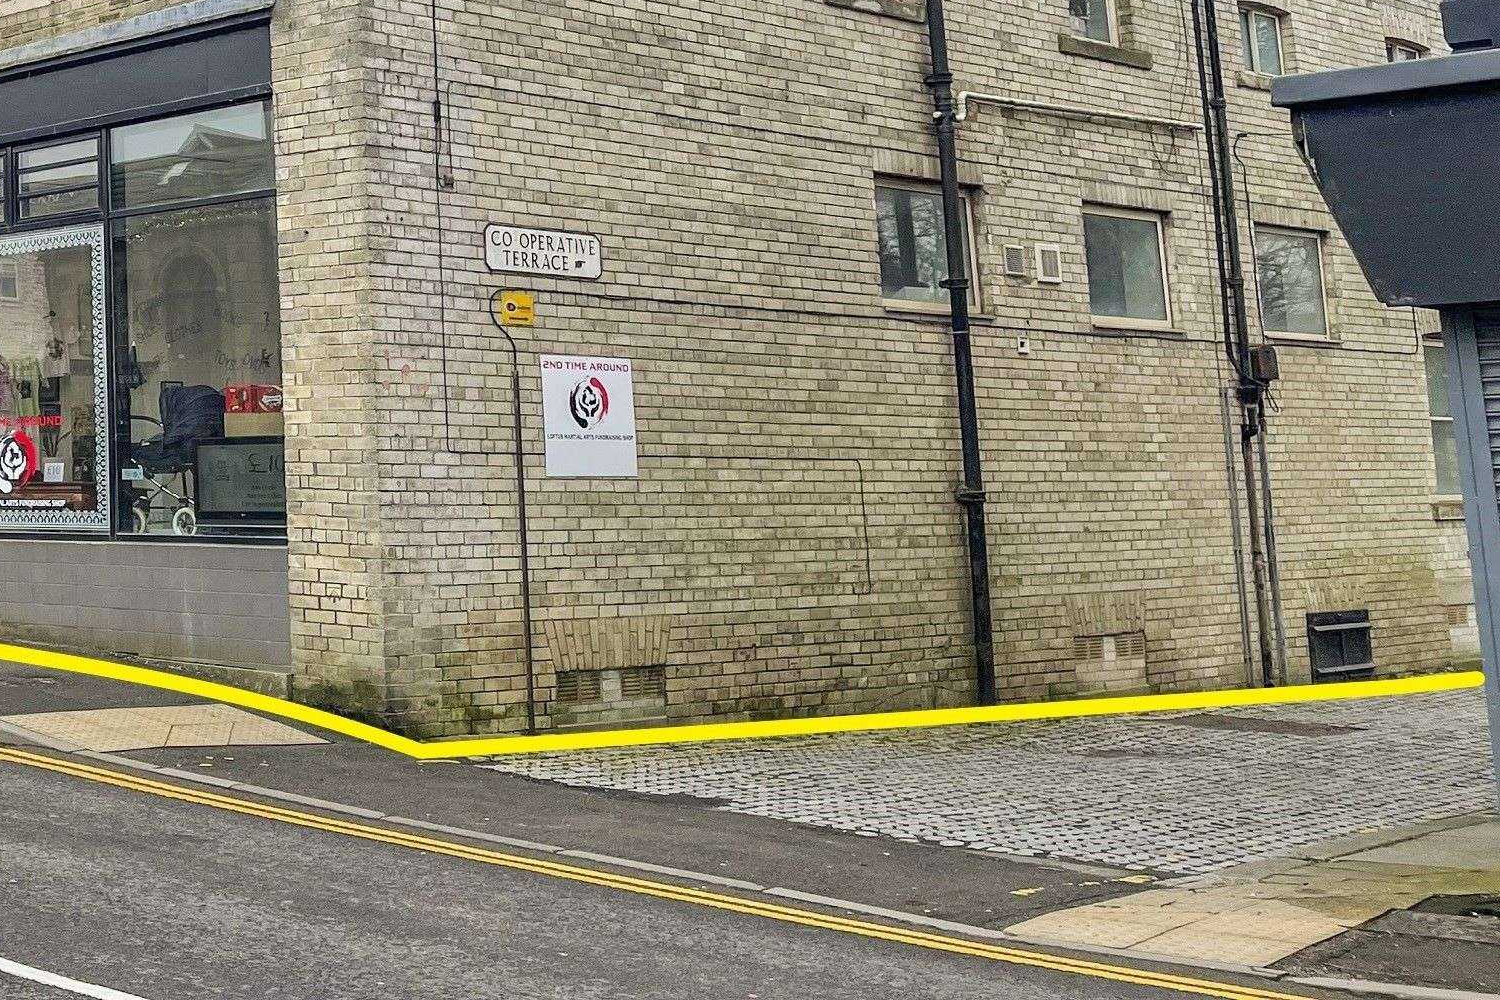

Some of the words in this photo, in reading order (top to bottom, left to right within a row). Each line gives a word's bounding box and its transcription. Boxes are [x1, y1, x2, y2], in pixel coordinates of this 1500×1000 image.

[491, 230, 512, 247] CO
[519, 233, 596, 256] OPERATIVE
[502, 249, 569, 271] TERRACE
[542, 360, 563, 370] 2ND
[565, 361, 587, 371] TIME
[589, 362, 629, 373] AROUND
